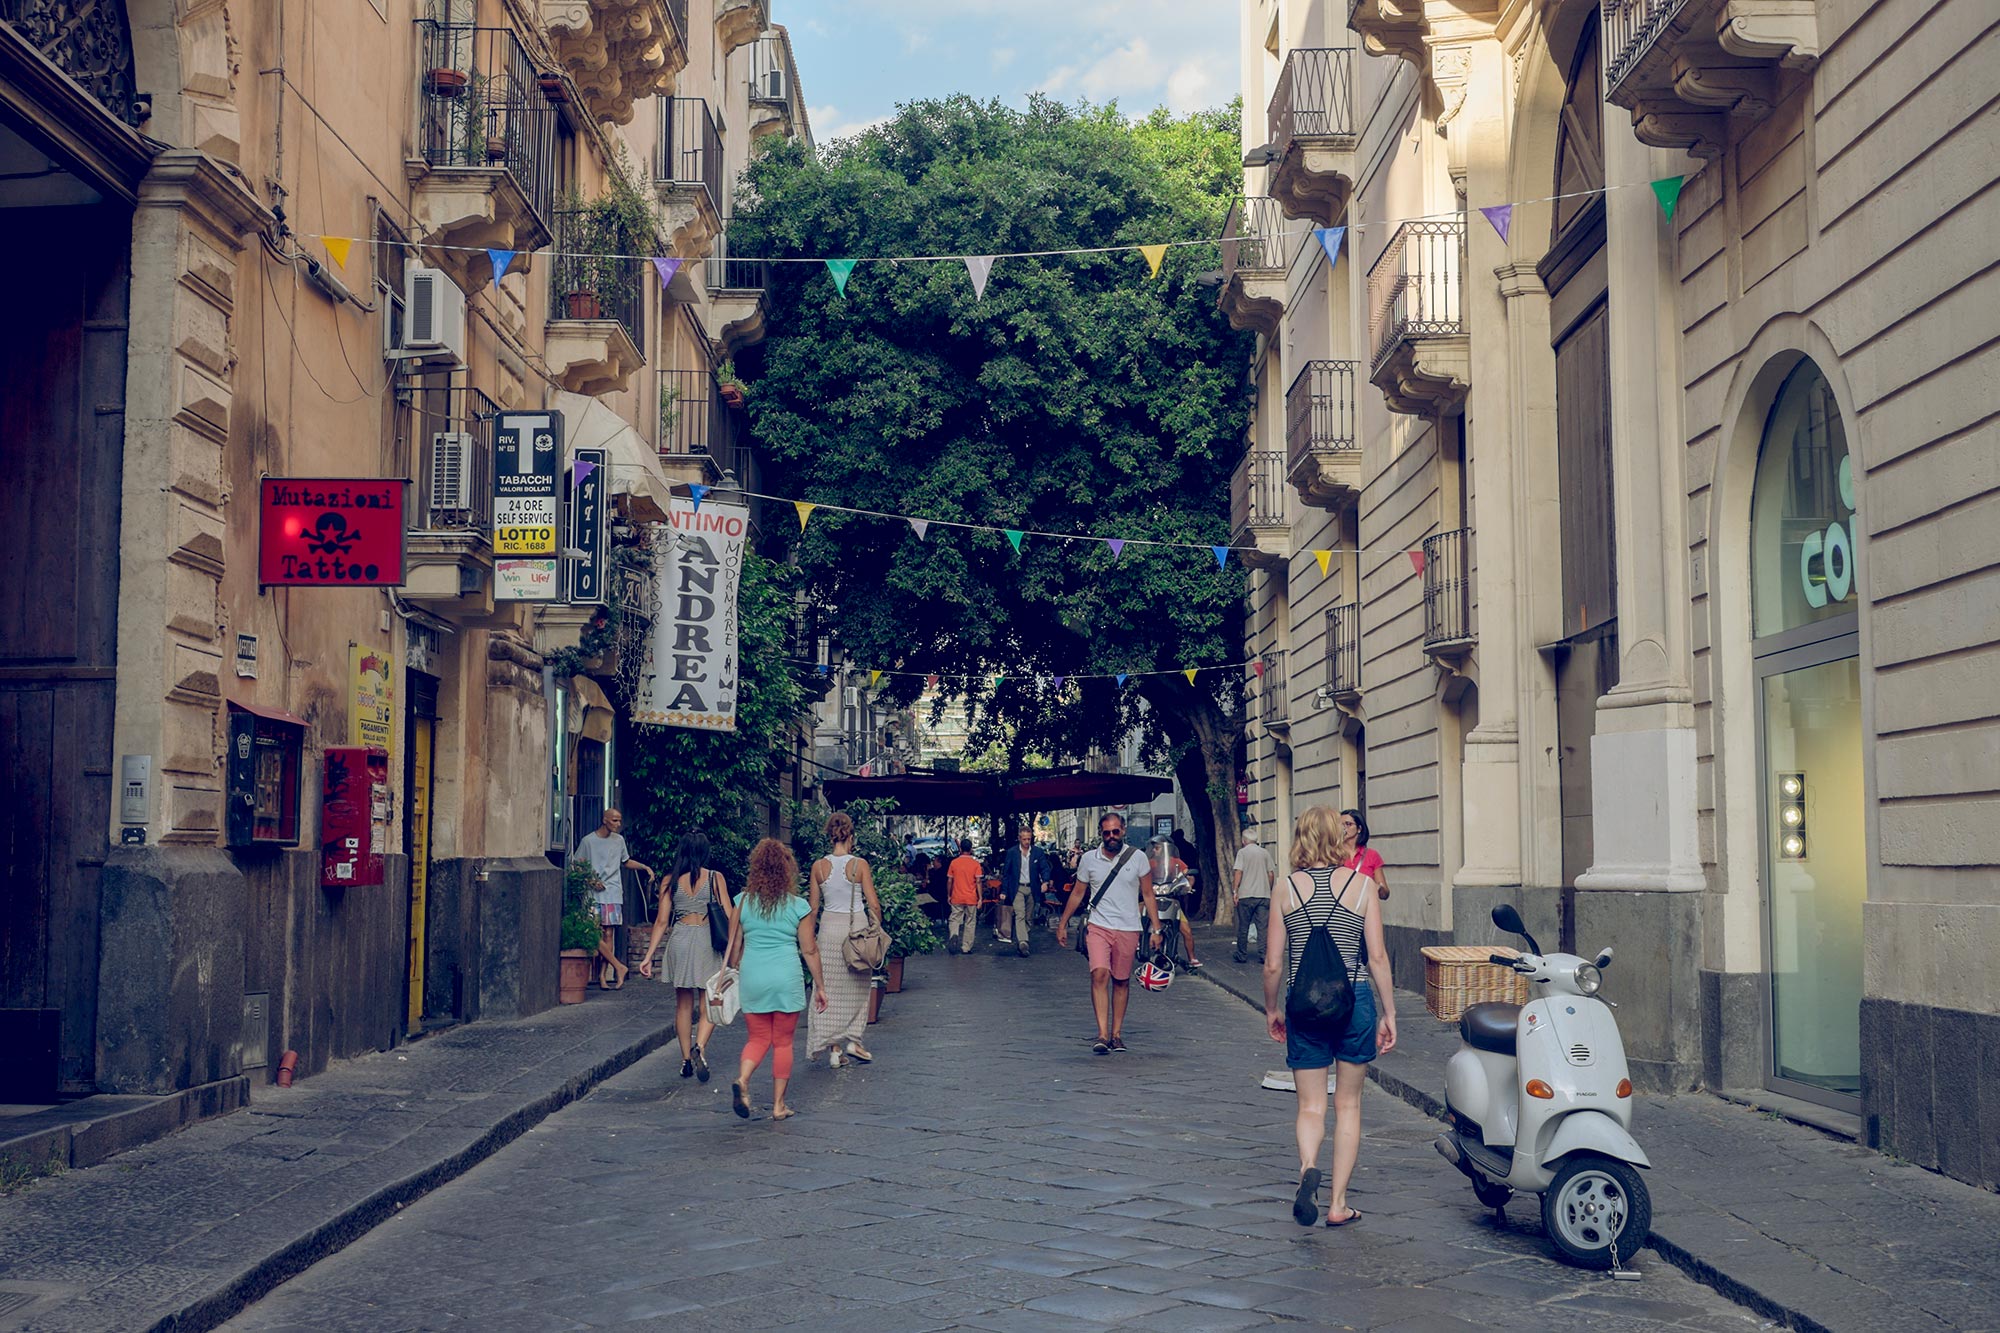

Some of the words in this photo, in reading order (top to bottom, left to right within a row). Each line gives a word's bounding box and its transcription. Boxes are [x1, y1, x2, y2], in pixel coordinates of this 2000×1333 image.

[499, 436, 515, 444] RIV.
[503, 415, 550, 474] T
[499, 475, 552, 485] TABACCHI
[272, 486, 395, 509] Mutazioni
[509, 500, 521, 511] 24
[524, 500, 543, 511] ORE
[497, 513, 516, 524] SELF
[518, 513, 553, 524] SERVICE
[669, 510, 743, 537] NTIMO
[499, 528, 550, 541] LOTTO
[503, 542, 522, 550] RIC.
[525, 542, 546, 550] 1688
[281, 555, 379, 580] Tattoo
[502, 571, 521, 582] Win
[666, 536, 720, 712] ANDREA
[360, 722, 389, 735] PAGAMENTI
